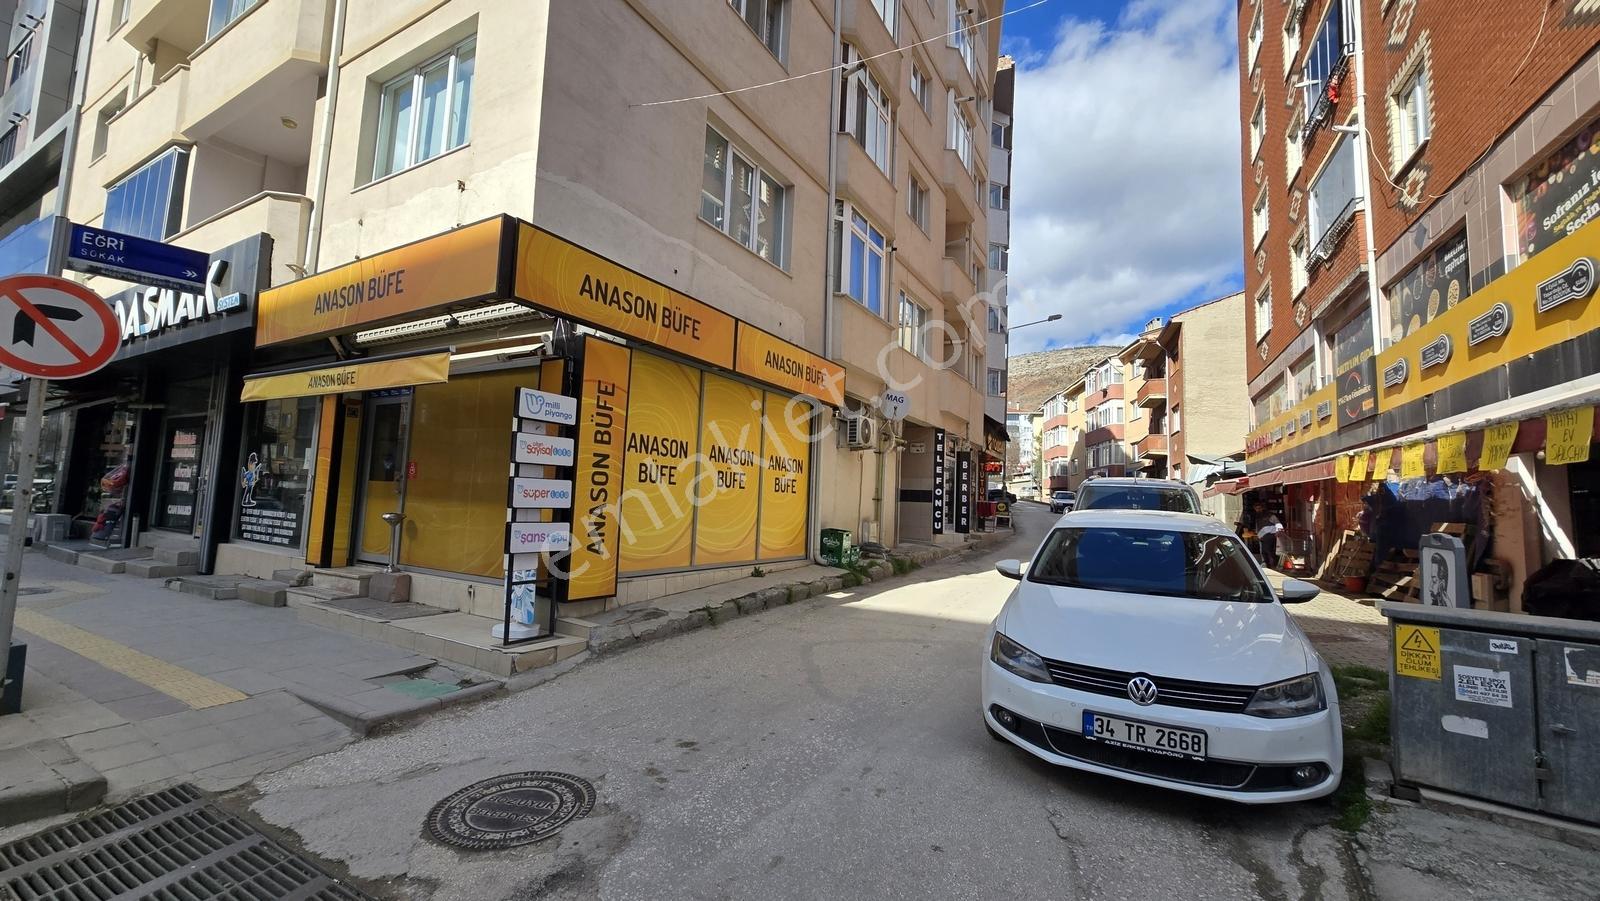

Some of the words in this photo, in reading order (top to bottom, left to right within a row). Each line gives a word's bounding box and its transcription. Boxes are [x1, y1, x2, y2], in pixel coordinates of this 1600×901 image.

[1543, 183, 1590, 231] Sofranız
[82, 231, 125, 251] EĞRİ
[80, 248, 125, 264] SOKAK
[314, 281, 365, 316] ANASON
[367, 270, 405, 301] BÜFE
[579, 274, 657, 324] ANASON
[662, 306, 702, 341] BÜFE
[765, 350, 804, 378] ANASON
[804, 364, 827, 386] BÜFE
[308, 374, 335, 389] ANASON
[336, 369, 356, 386] BÜFE
[545, 401, 561, 410] milli
[886, 393, 904, 404] MAG
[544, 409, 573, 420] piyango
[591, 380, 615, 446] BÜFE
[627, 432, 689, 459] ANASON
[709, 444, 754, 467] ANASON
[638, 459, 677, 486] BÜFE
[768, 455, 803, 474] ANASON
[717, 467, 746, 490] BÜFE
[774, 474, 797, 494] BÜFE
[934, 433, 943, 530] TELEFONCU
[523, 488, 551, 501] süper
[586, 452, 610, 555] ANASON
[520, 532, 546, 544] şans
[1401, 650, 1432, 661] DİKKAT
[1399, 663, 1439, 674] TEHLİKESİ
[1095, 718, 1115, 738] 34
[1125, 722, 1146, 744] TR
[1155, 729, 1202, 753] 2668
